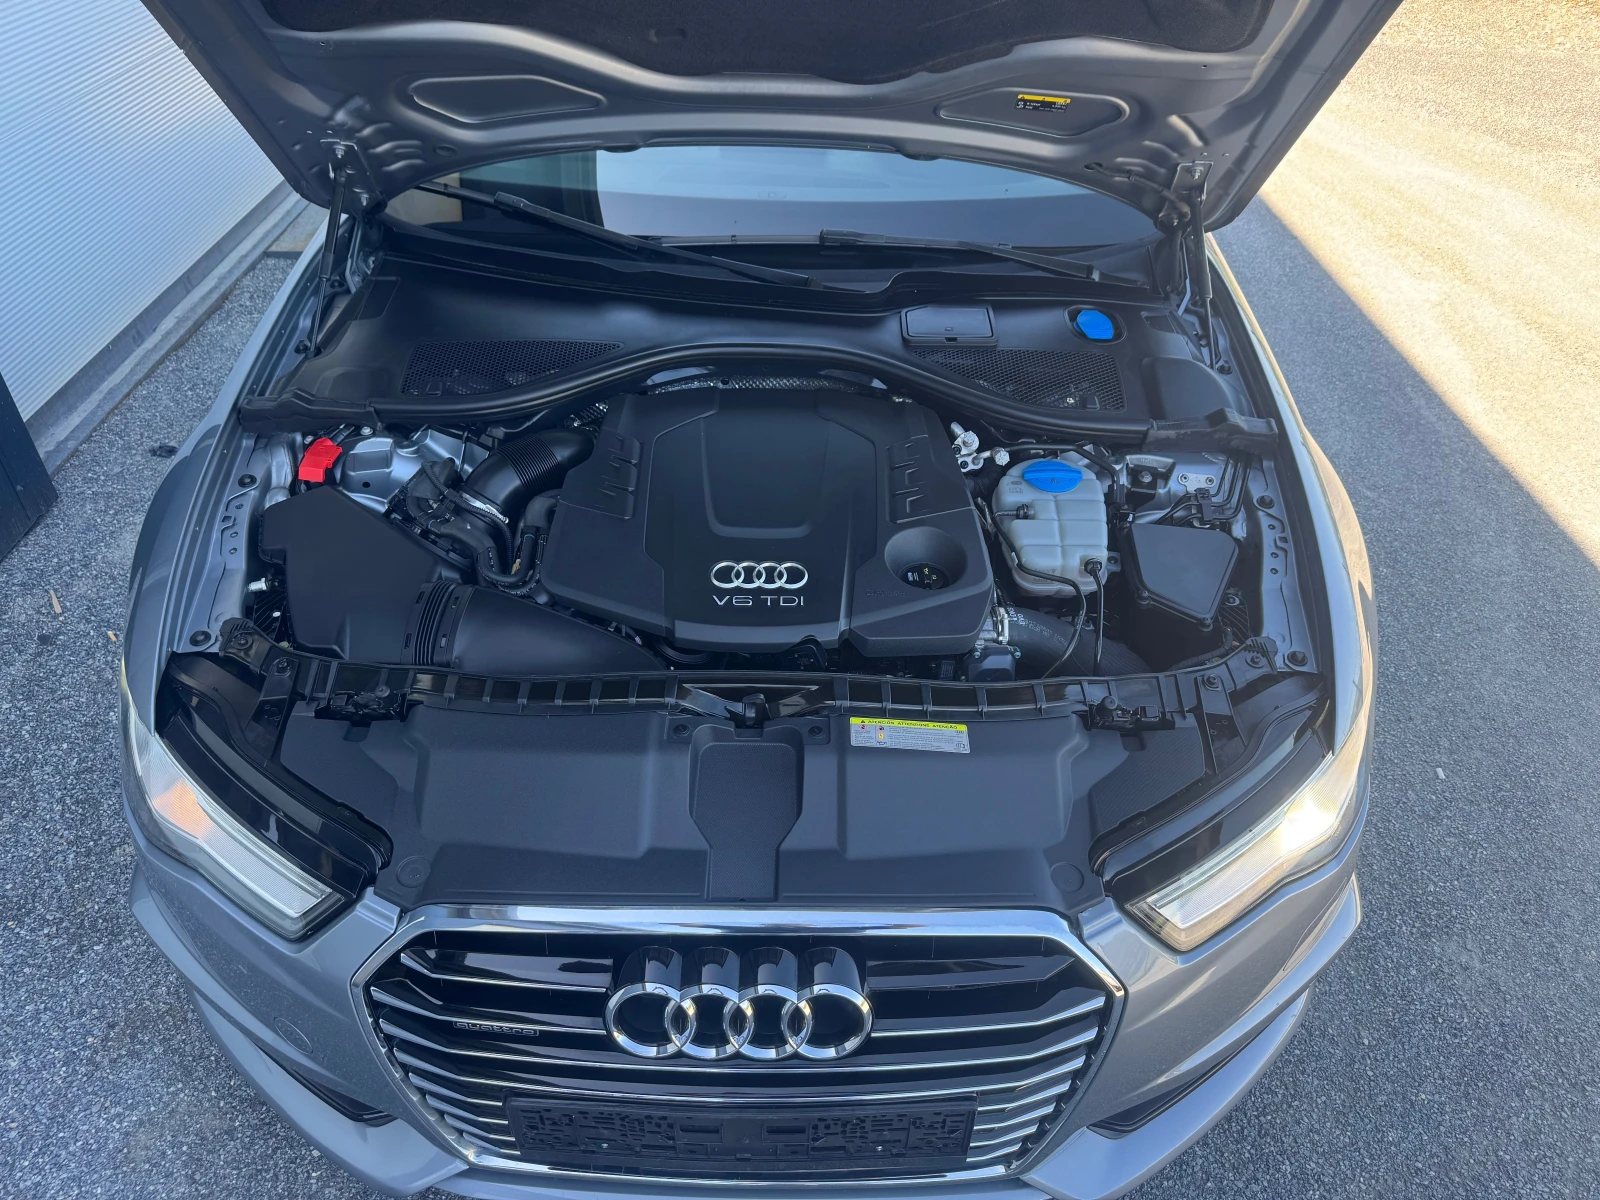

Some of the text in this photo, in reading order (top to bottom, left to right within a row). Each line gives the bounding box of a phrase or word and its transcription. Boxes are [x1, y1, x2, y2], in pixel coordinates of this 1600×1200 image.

[712, 595, 804, 606] V6 TDI
[456, 1022, 534, 1035] quattro
